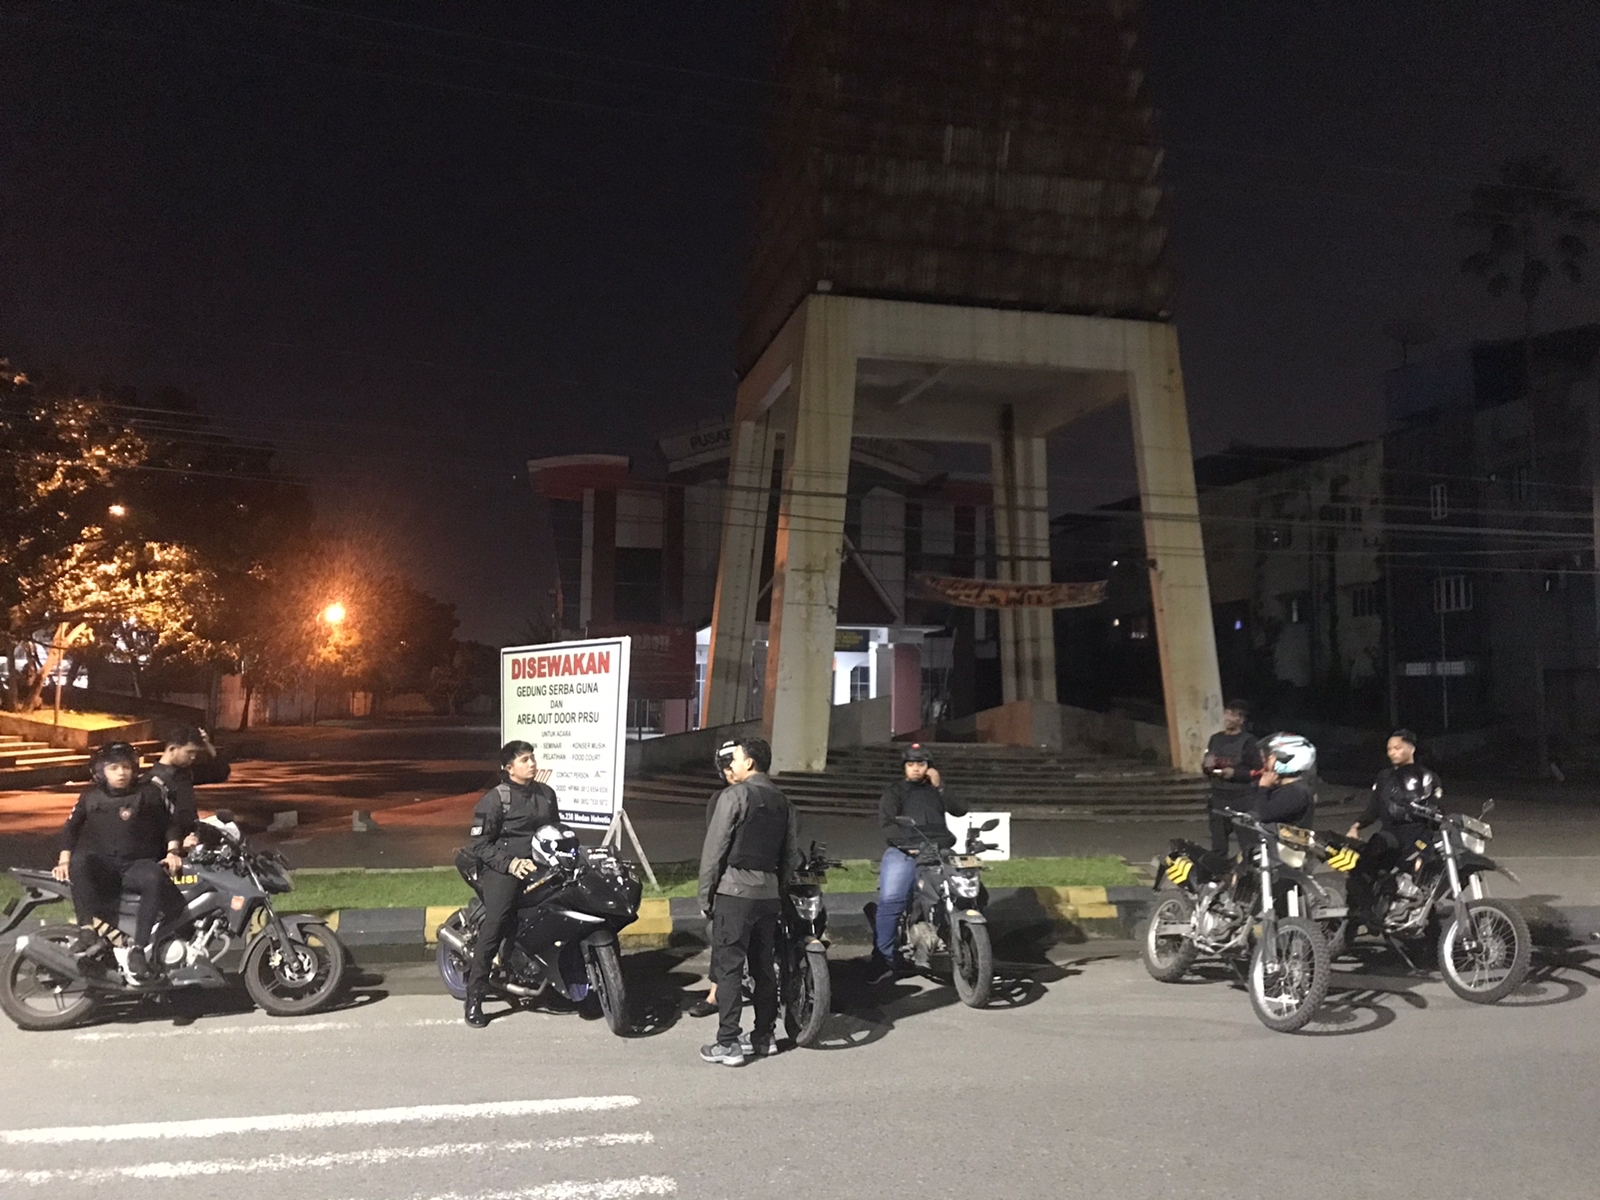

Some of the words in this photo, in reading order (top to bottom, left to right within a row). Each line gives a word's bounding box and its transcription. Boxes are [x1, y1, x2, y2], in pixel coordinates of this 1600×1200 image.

[689, 428, 732, 450] PUSAT
[511, 651, 610, 680] DISEWAKAN
[516, 685, 547, 697] GEDUNG
[548, 683, 575, 696] SERBA
[576, 682, 599, 694] GUNA
[550, 699, 564, 709] DAN
[517, 713, 537, 725] AREA
[537, 712, 553, 724] OUT
[554, 712, 577, 724] DOOR
[578, 711, 600, 723] PRSU
[541, 730, 556, 738] UNTUK
[574, 813, 590, 822] Medan
[171, 874, 198, 885] LISI
